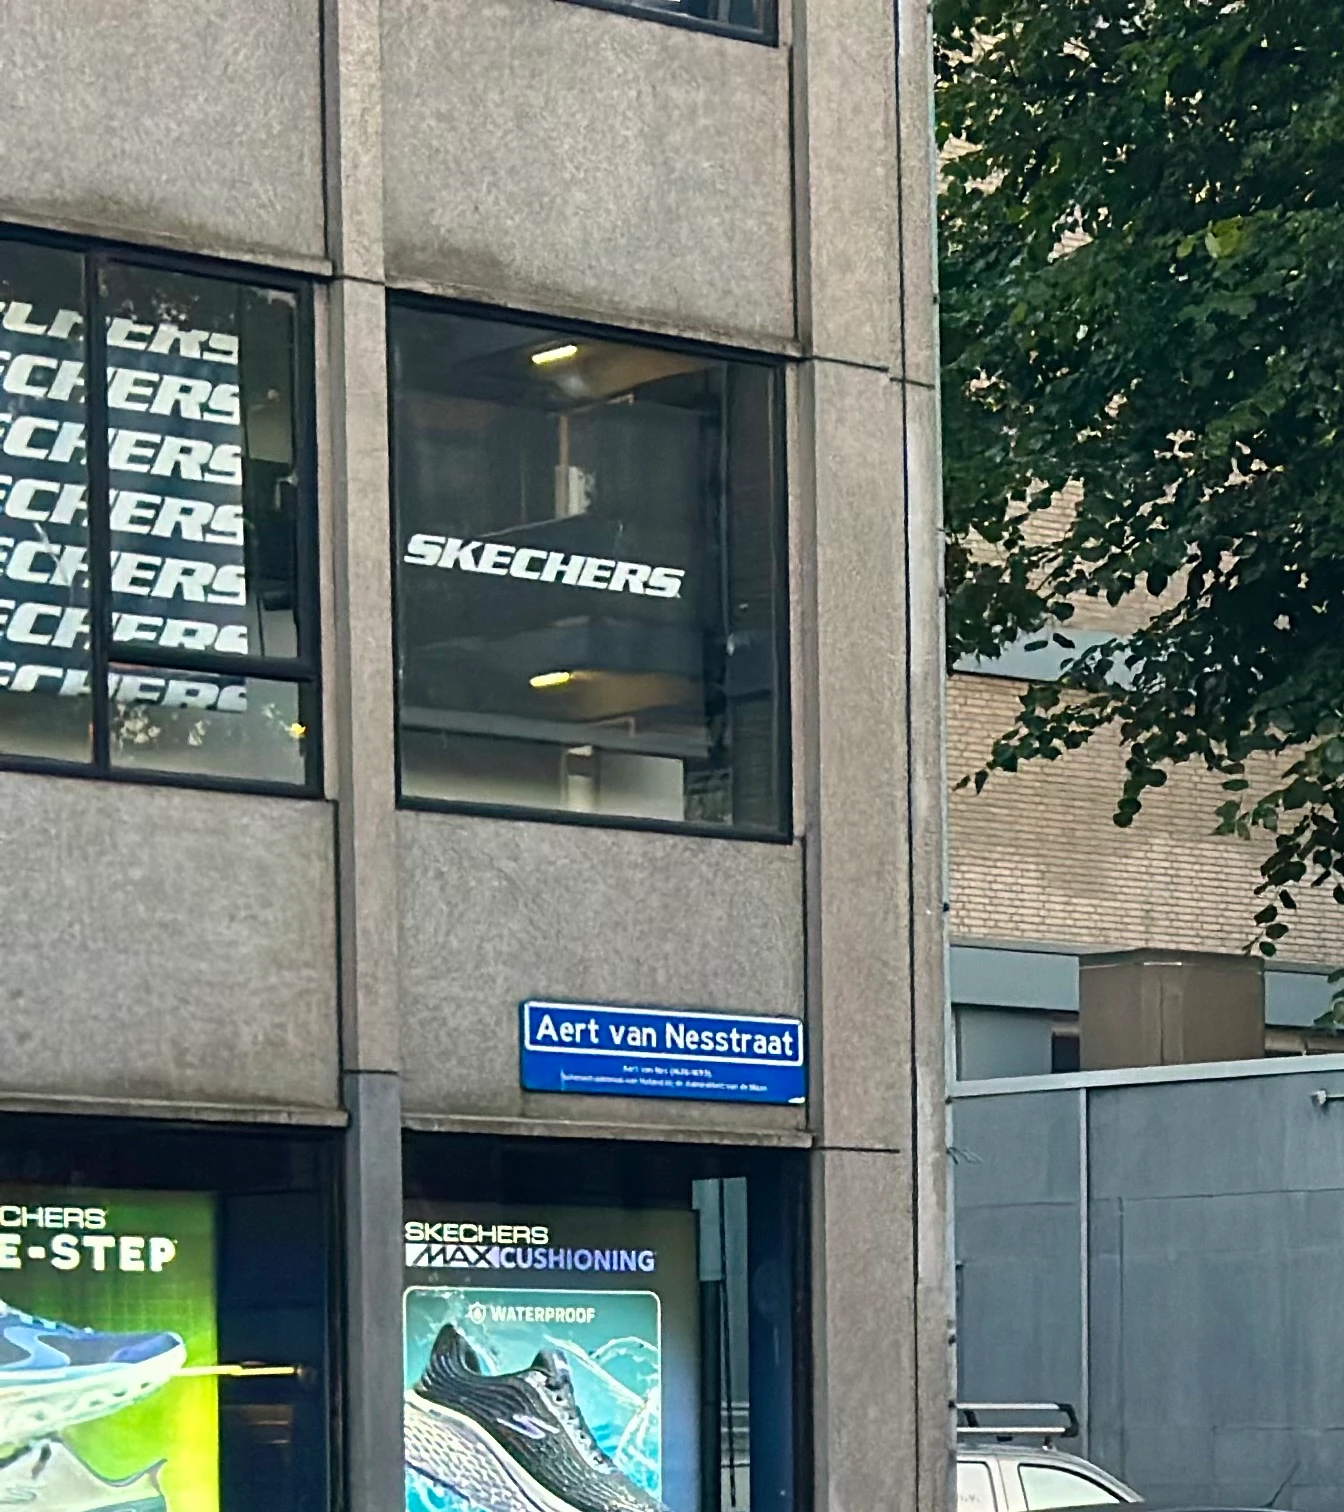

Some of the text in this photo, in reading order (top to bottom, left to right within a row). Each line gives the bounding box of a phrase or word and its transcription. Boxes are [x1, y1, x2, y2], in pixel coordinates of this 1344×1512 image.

[0, 301, 239, 365] CHERS
[0, 350, 241, 425] CHERS
[0, 412, 243, 486] CHERS
[404, 533, 685, 598] SKECHERS
[536, 1013, 794, 1057] Aert van Nesstraat
[0, 1233, 176, 1273] E-STEP
[404, 1221, 549, 1245] SKECHERS
[500, 1248, 656, 1272] CUSHIONING
[490, 1305, 596, 1324] WATERPROOF
